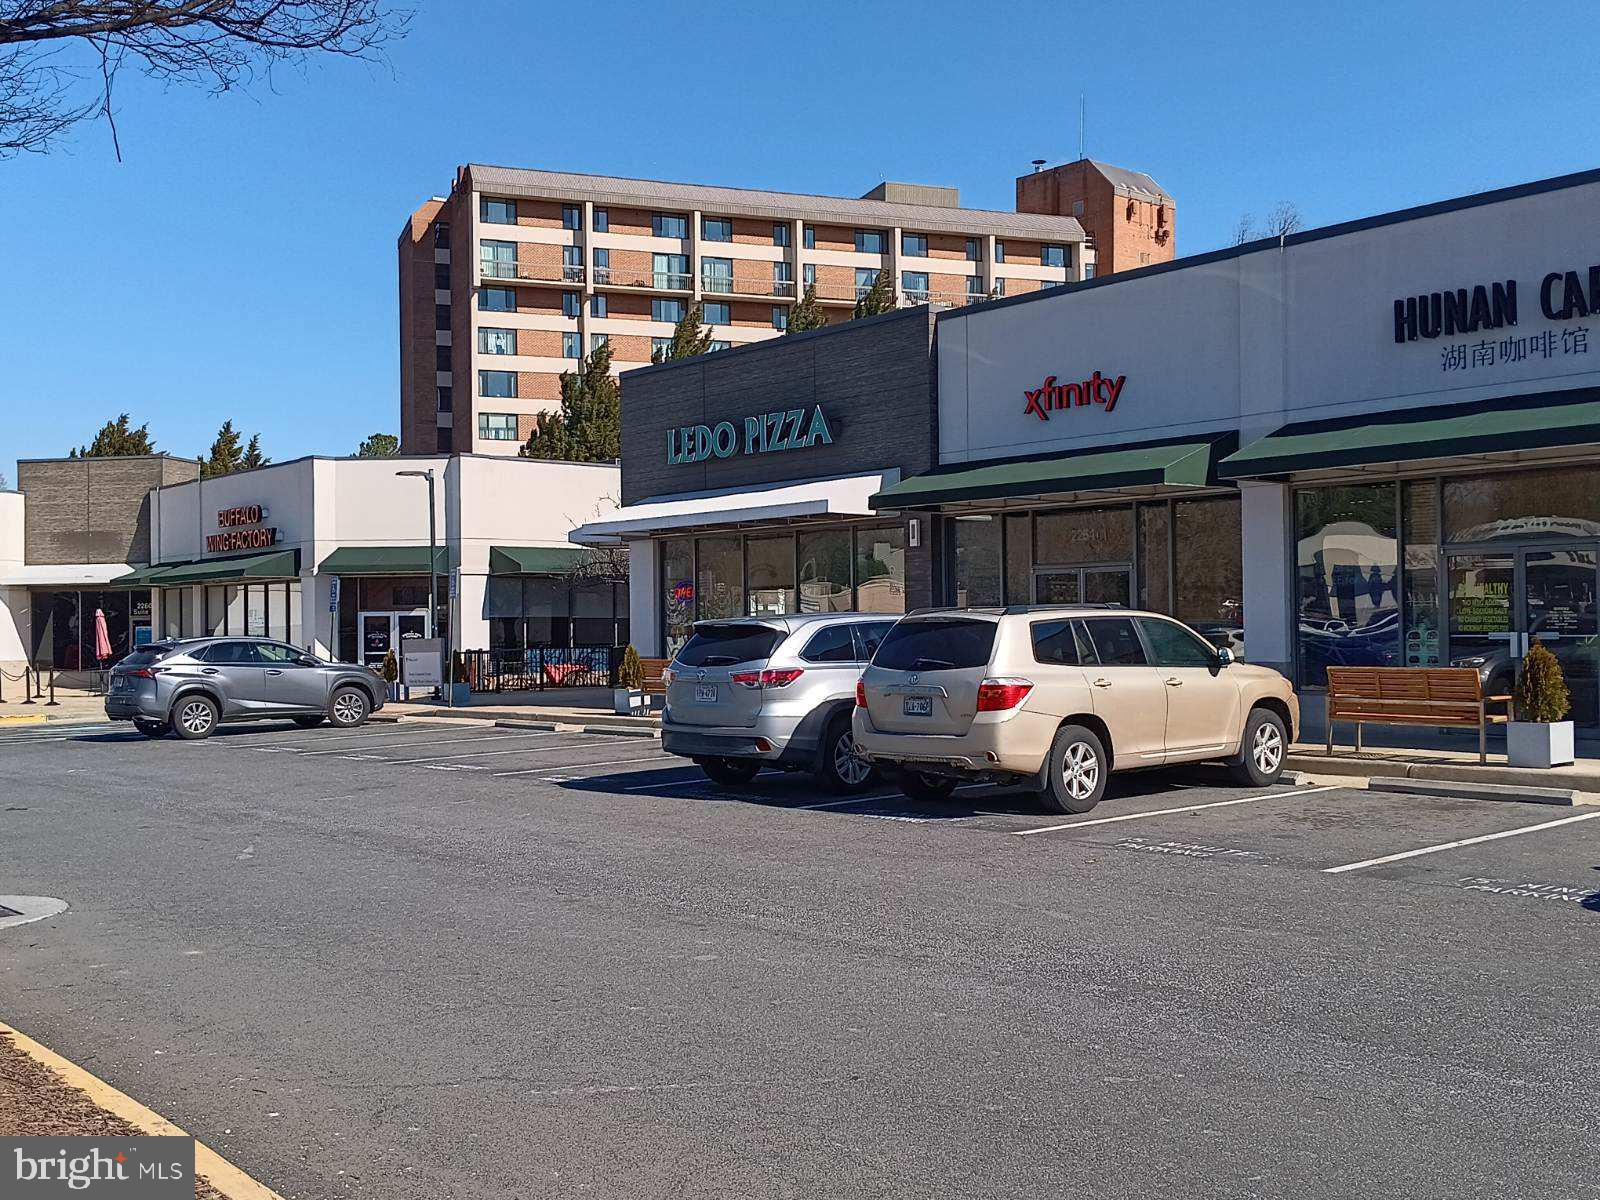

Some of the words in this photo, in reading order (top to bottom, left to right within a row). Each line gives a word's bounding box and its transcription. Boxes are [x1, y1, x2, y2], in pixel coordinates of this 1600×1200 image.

[1394, 280, 1517, 343] HUNAN
[1441, 327, 1590, 372] 湖南咖啡馆
[1024, 370, 1127, 421] xfinity
[666, 421, 737, 465] LEDO
[744, 404, 834, 455] PIZZA
[217, 505, 262, 527] BUFFALO
[231, 528, 275, 550] FACTORY
